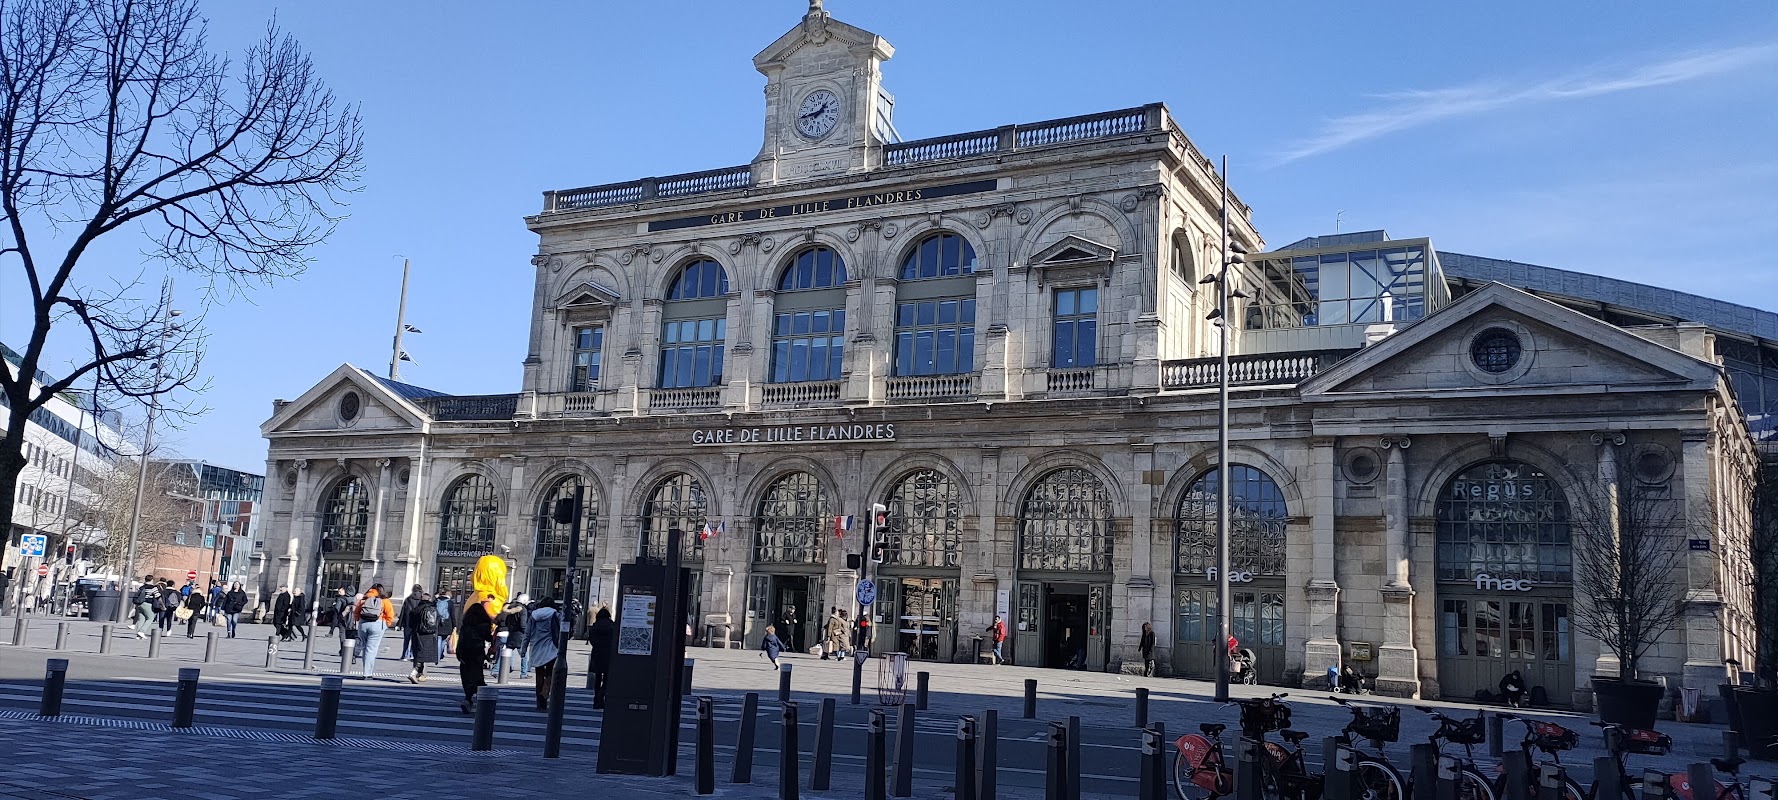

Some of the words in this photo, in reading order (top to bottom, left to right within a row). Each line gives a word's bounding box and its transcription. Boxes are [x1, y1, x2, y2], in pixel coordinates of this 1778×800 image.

[711, 211, 744, 225] GARE
[759, 207, 776, 220] DE
[792, 200, 830, 216] LILLE
[847, 189, 922, 209] FLANDRES
[692, 429, 733, 444] GARE
[740, 428, 760, 443] DE
[767, 427, 803, 442] LILLE
[810, 423, 895, 440] FLANDRES
[1454, 481, 1533, 501] Regus
[1205, 566, 1253, 583] fac
[1476, 573, 1533, 592] fnac
